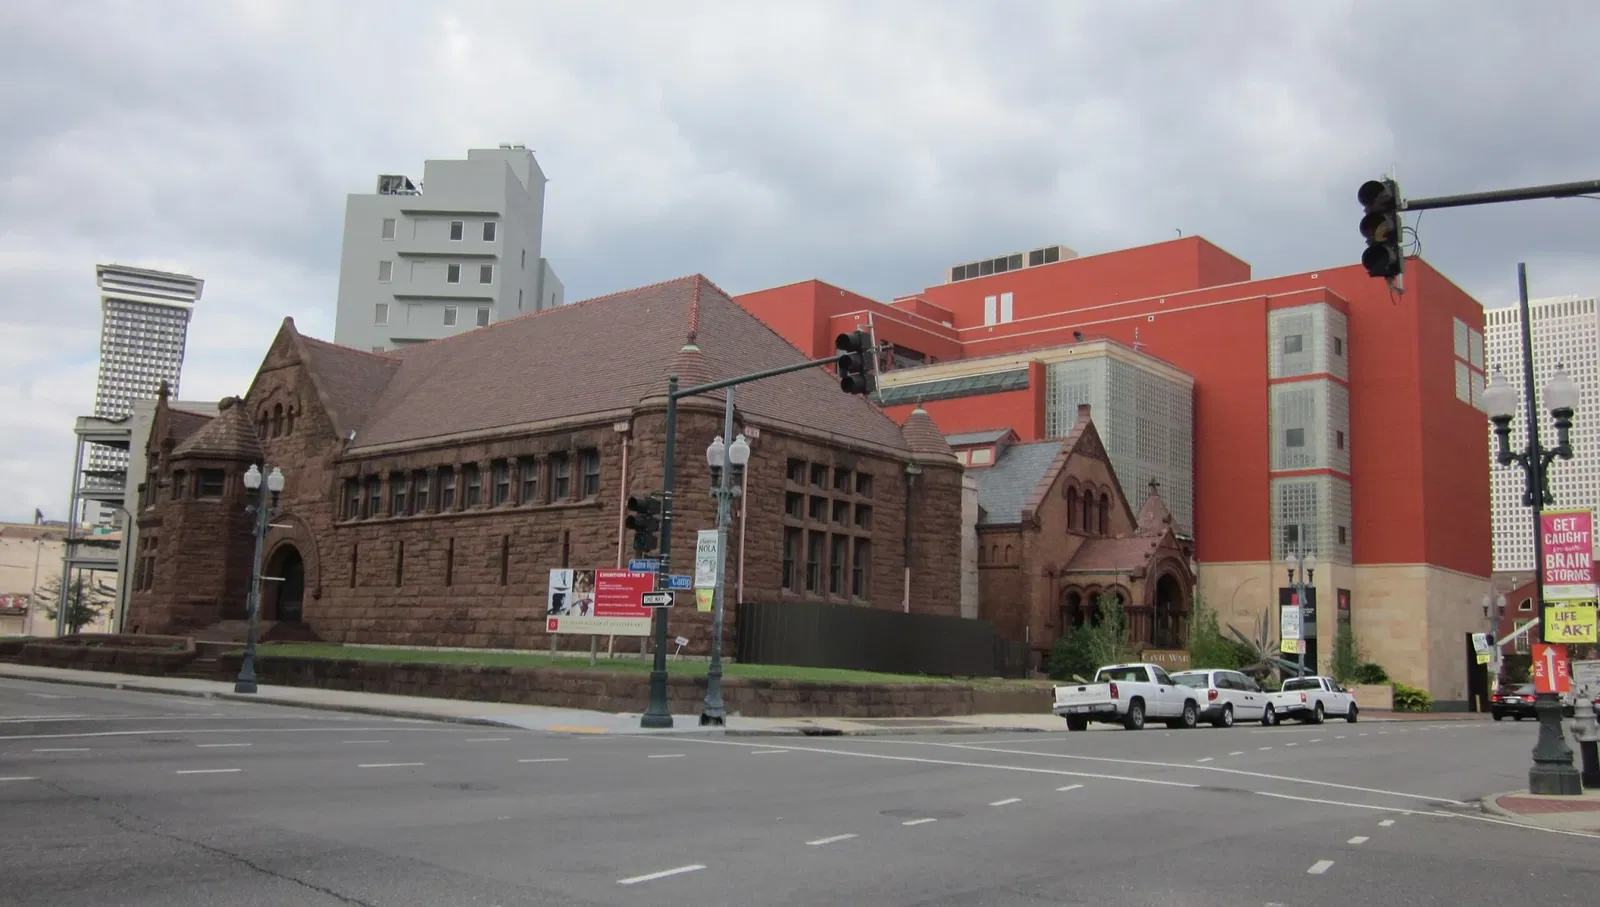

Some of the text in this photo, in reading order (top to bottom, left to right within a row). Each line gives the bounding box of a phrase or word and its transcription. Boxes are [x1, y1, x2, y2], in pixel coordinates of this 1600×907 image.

[1553, 517, 1577, 531] GET
[1545, 531, 1589, 545] CAUGHT
[698, 544, 716, 553] NOLA
[1545, 552, 1590, 570] BRAIN
[672, 577, 691, 588] Camp
[1546, 569, 1591, 582] STORMS
[1554, 611, 1577, 622] LIFE
[1561, 623, 1592, 637] ART
[1168, 653, 1189, 663] WAR
[1535, 660, 1543, 677] PLK
[1558, 660, 1566, 677] PLK
